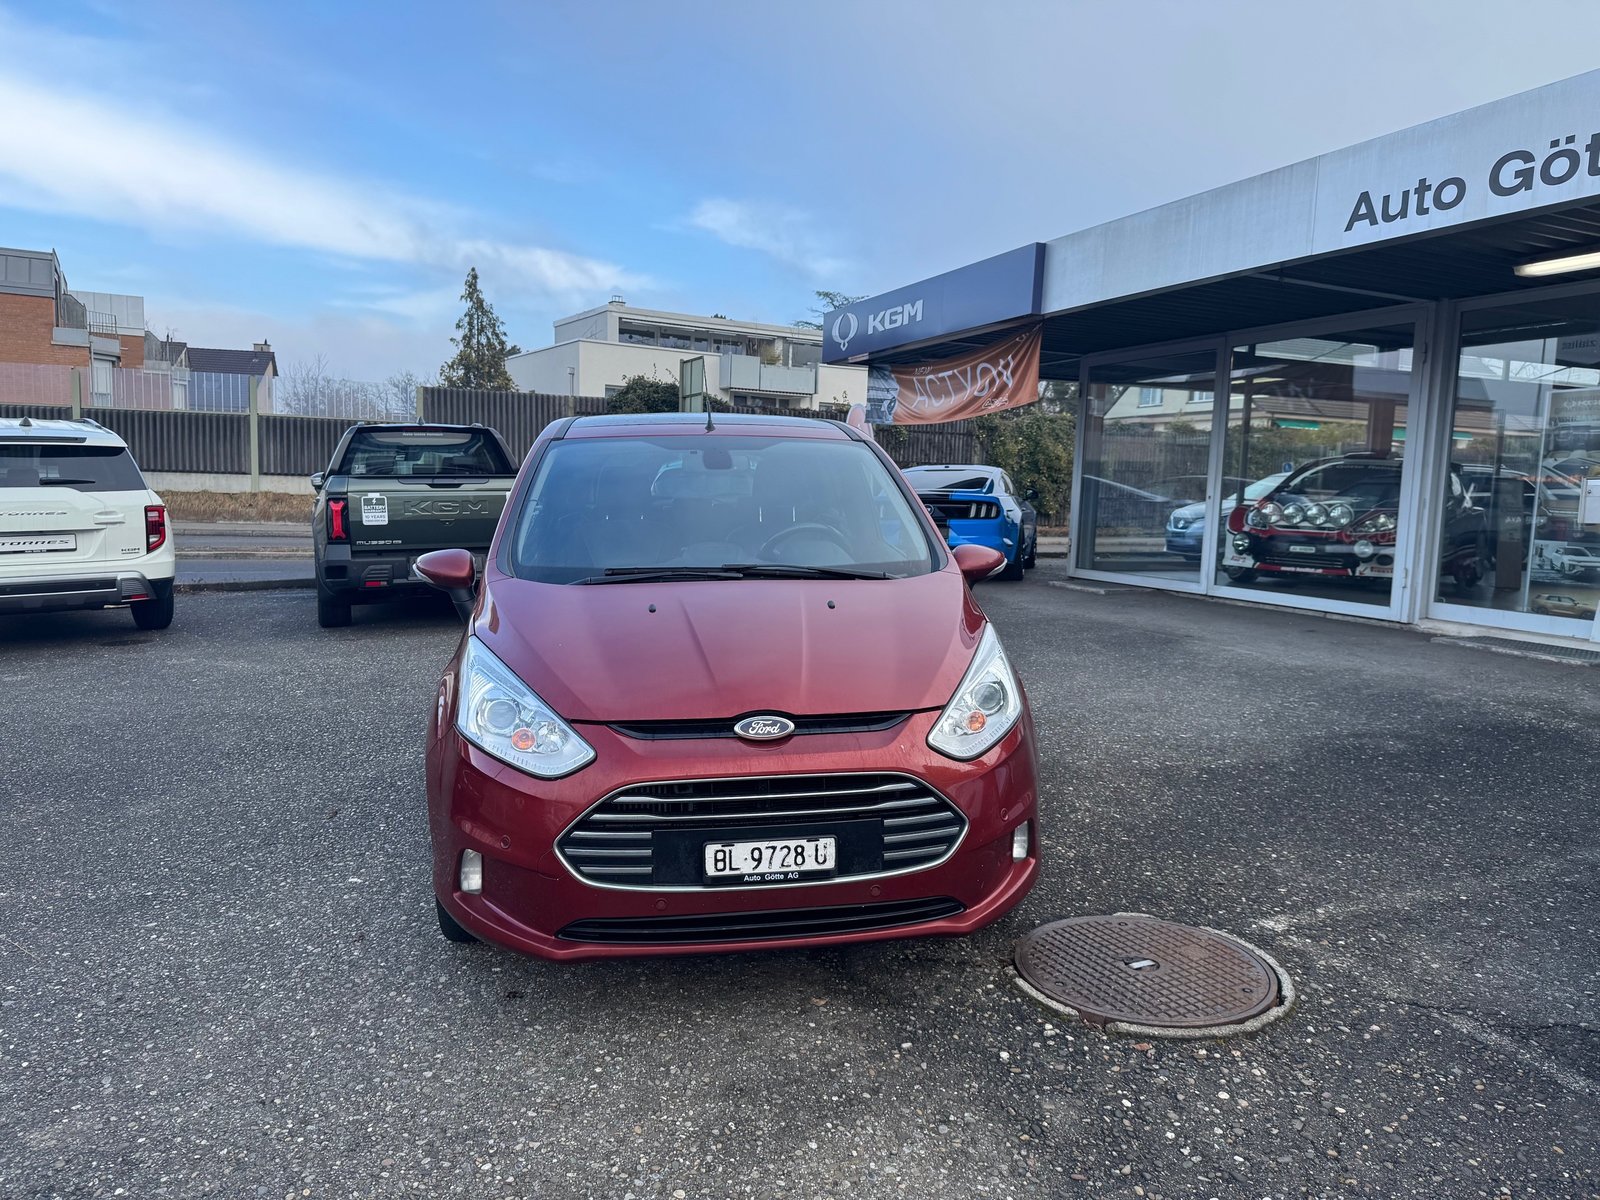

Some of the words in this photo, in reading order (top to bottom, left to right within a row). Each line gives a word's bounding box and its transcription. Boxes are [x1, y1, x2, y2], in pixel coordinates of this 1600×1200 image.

[1343, 177, 1467, 233] Auto
[867, 299, 924, 335] KGM
[911, 354, 1015, 409] ACTYON
[404, 500, 489, 515] KGM
[748, 720, 781, 735] Ford
[743, 874, 762, 882] Auto
[764, 873, 785, 881] Götte
